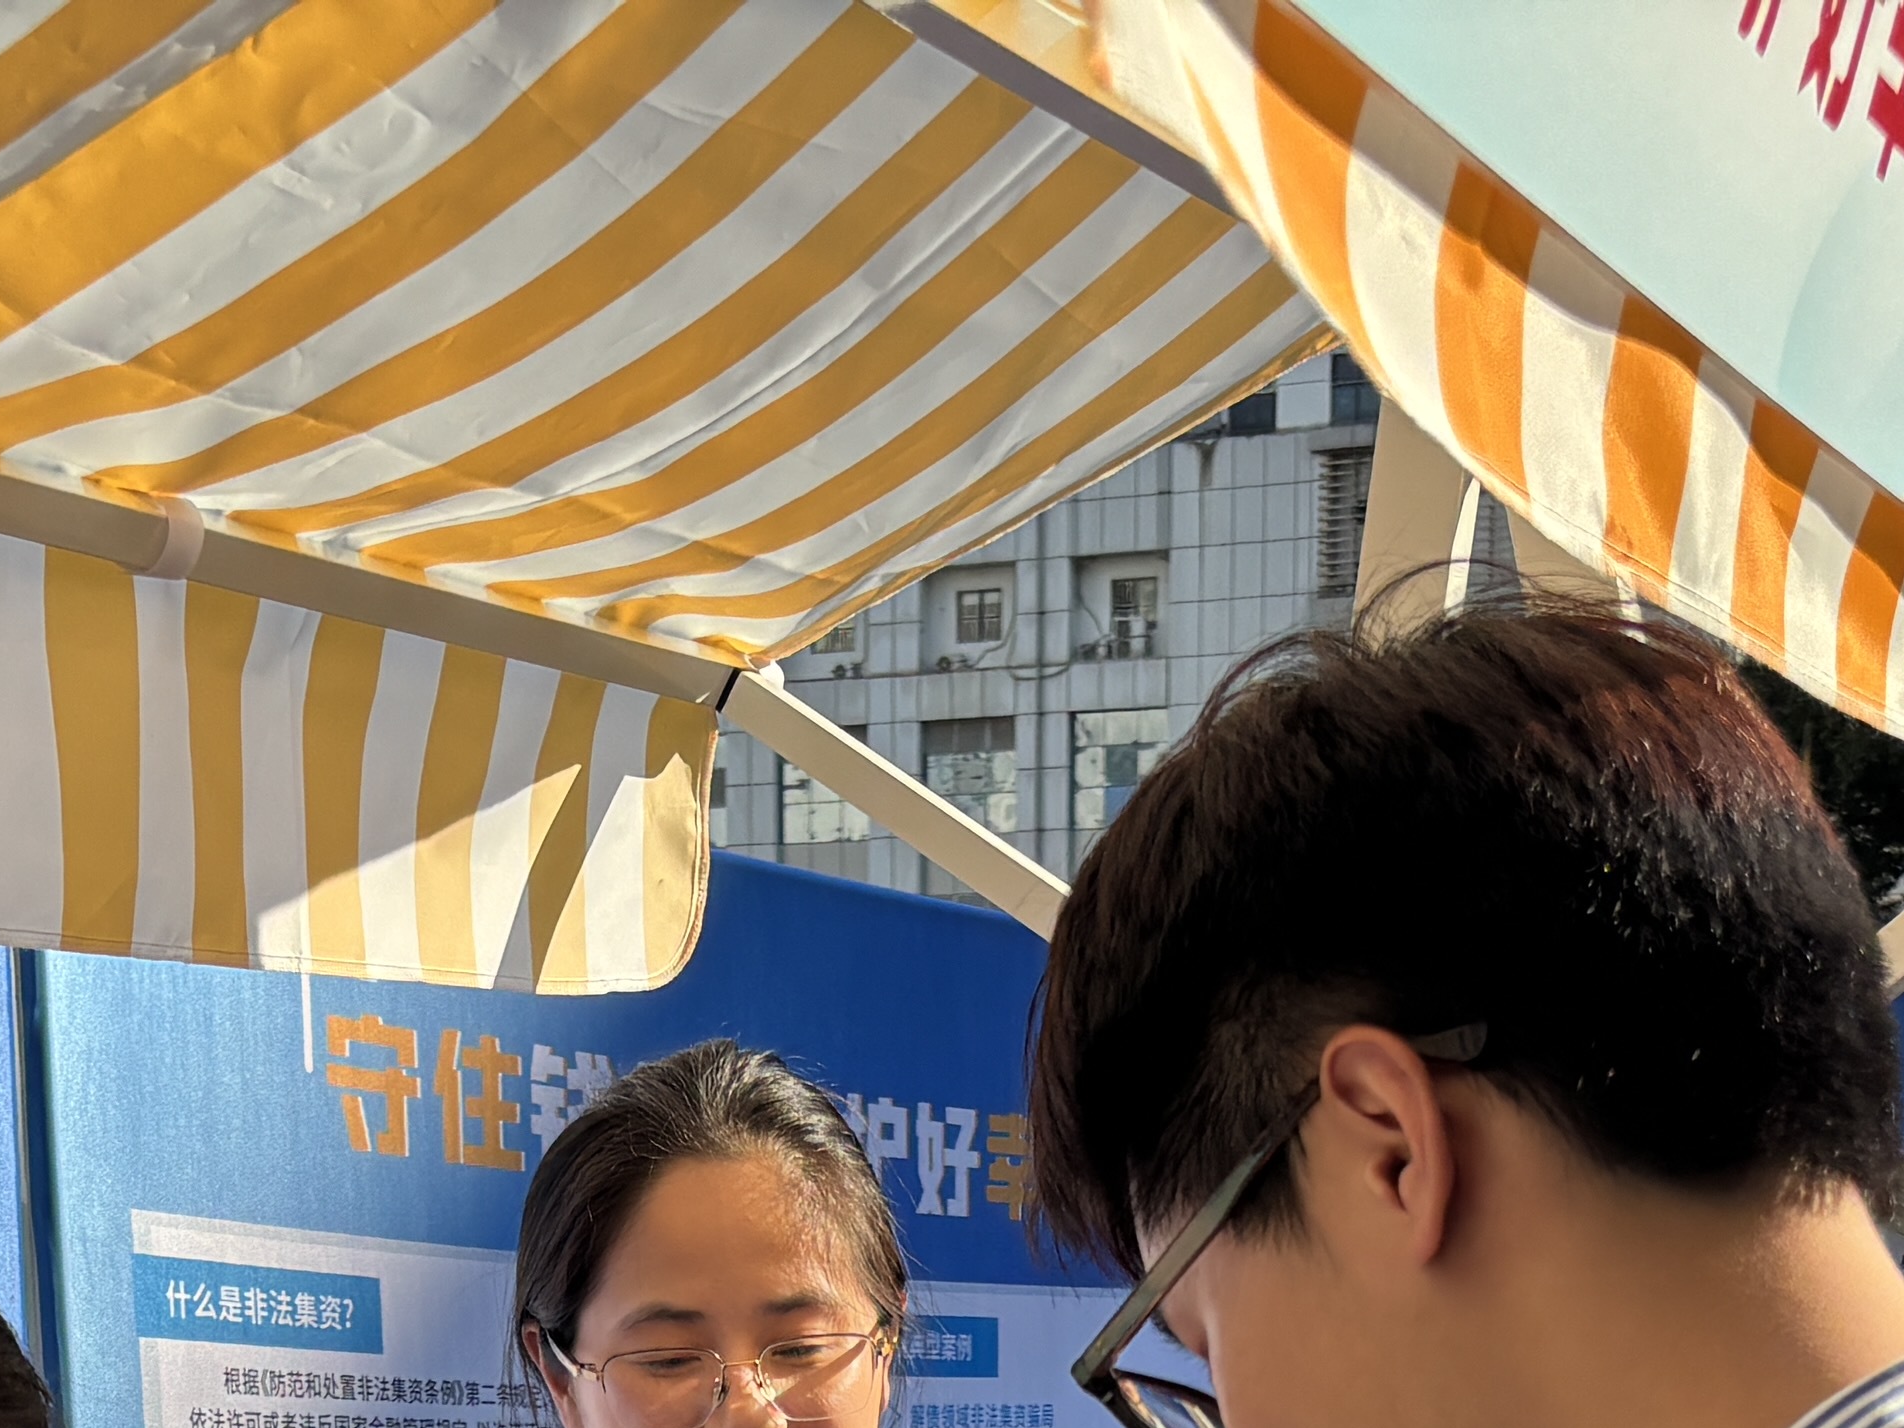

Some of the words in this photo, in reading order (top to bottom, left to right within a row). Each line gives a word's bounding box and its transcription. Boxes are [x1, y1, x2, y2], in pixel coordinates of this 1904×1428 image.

[165, 1279, 355, 1331] 什么是非法集资?
